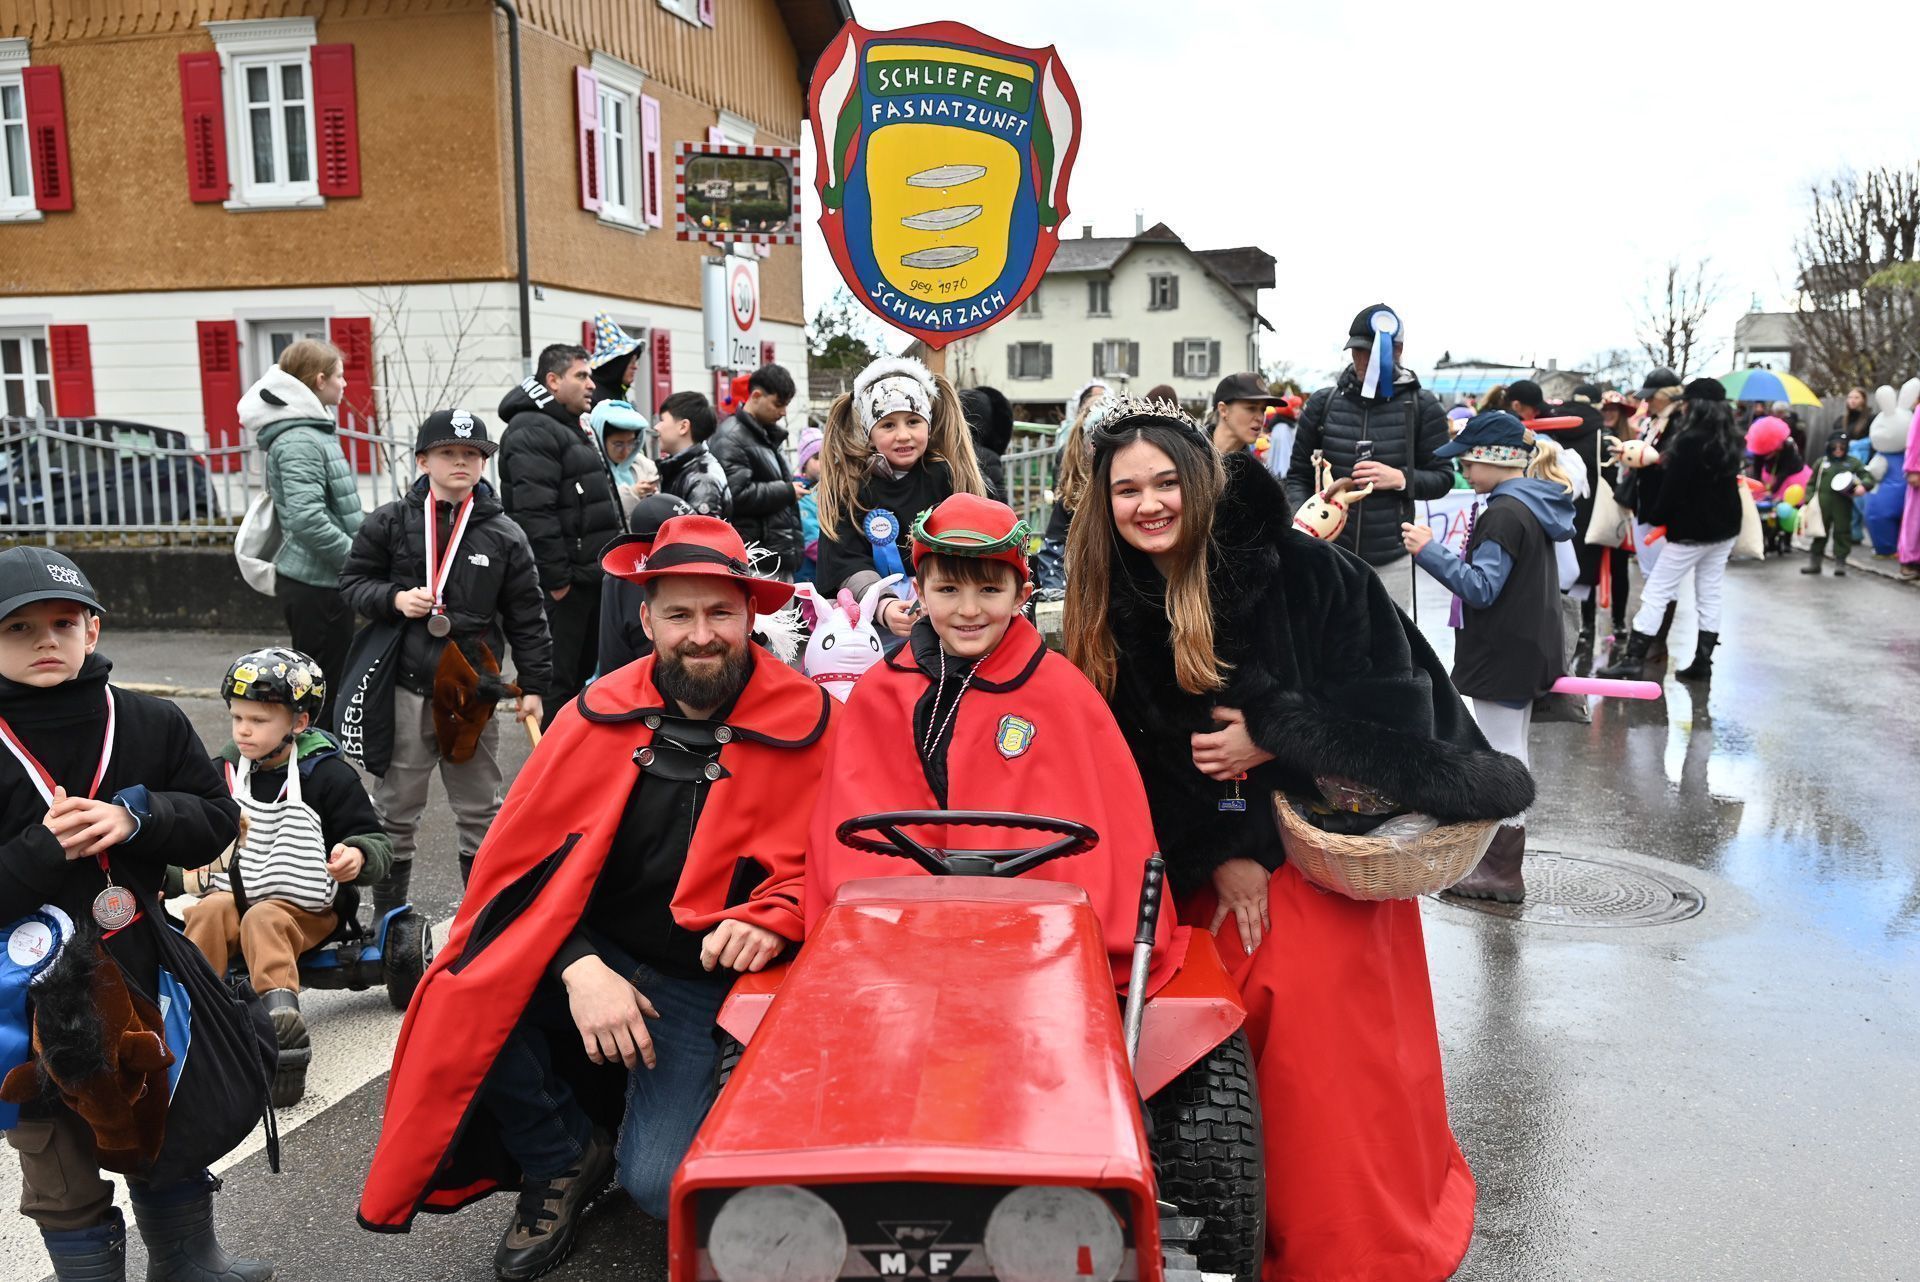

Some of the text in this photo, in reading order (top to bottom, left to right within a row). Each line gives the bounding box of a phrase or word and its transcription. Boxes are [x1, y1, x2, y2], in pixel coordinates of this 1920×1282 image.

[878, 66, 1014, 102] SCHLIEFER
[871, 99, 1029, 136] FASNATZUNFT
[871, 281, 1006, 326] SCHWARZACH
[909, 279, 933, 294] geg.
[733, 337, 756, 366] Zone
